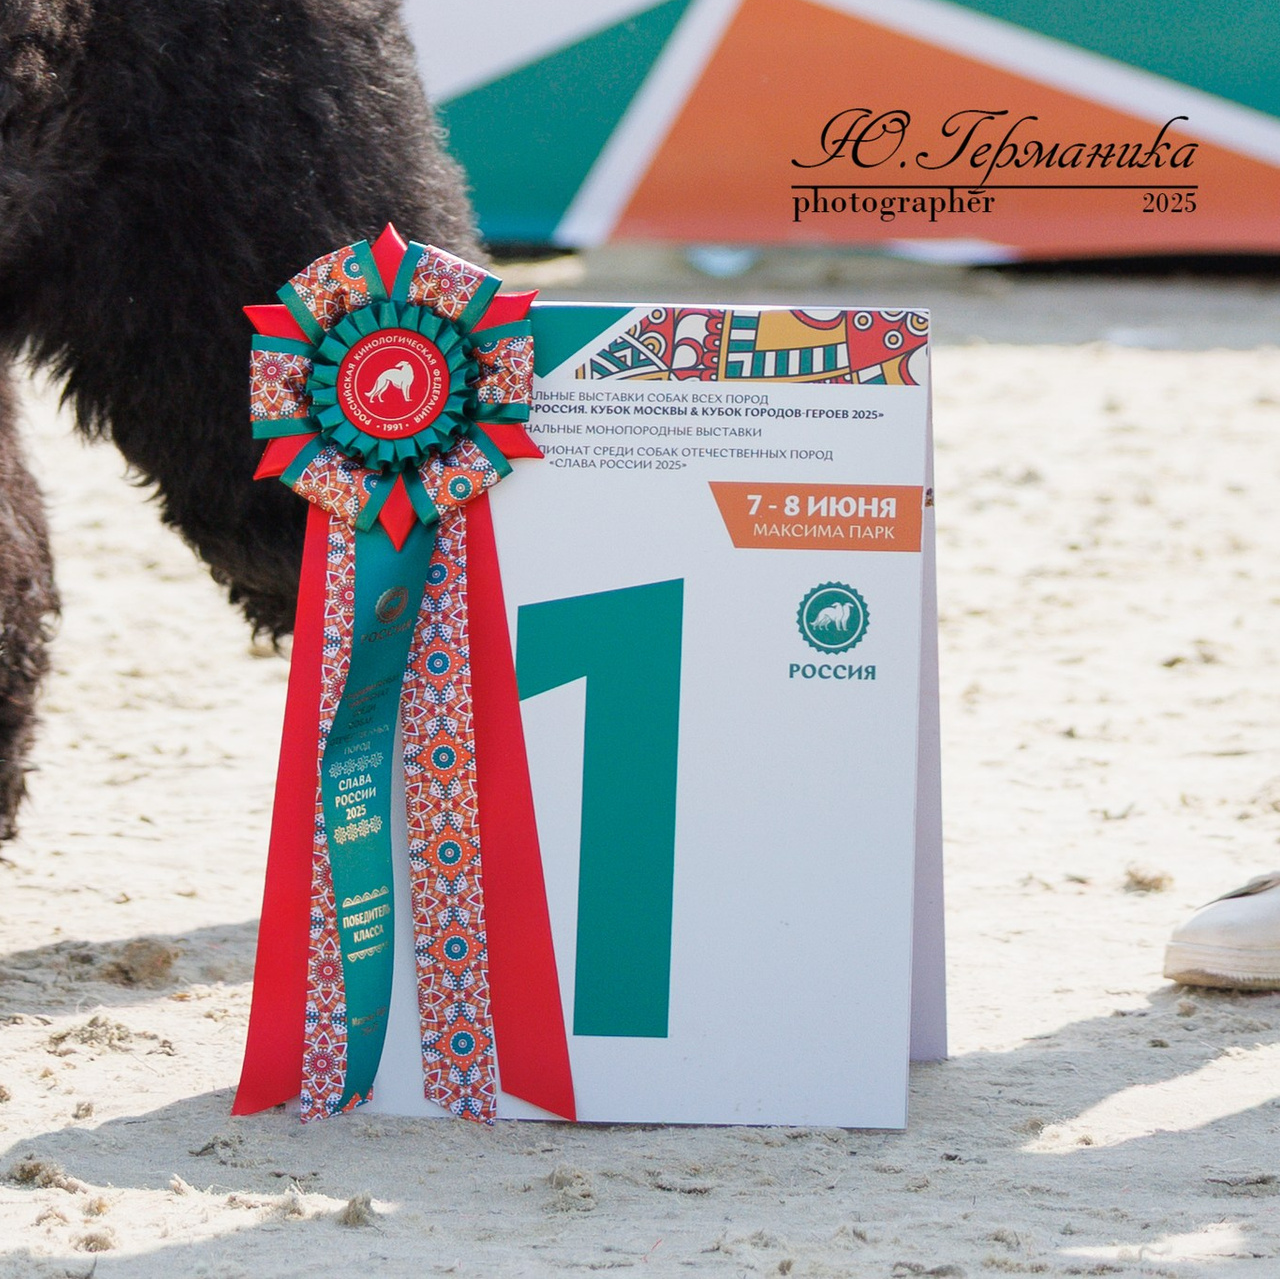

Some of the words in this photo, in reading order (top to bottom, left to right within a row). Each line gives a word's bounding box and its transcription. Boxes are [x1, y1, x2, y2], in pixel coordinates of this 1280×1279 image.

[353, 335, 437, 366] КИНОЛОГИЧЕСКАЯ
[343, 362, 372, 426] РОССИЙСКАЯ
[413, 368, 442, 424] ФЕДЕРАЦИЯ
[578, 392, 644, 403] ВЫСТАВКИ
[647, 392, 688, 404] СОБАК
[691, 393, 723, 404] ВСЕХ
[725, 394, 769, 405] ПОРОД
[590, 405, 631, 415] КУБОК
[633, 405, 687, 416] МОСКВЫ
[690, 407, 699, 417] &
[701, 407, 742, 417] КУБОК
[744, 408, 849, 419] ГОРОДОВ-ГЕРОЕВ
[851, 409, 884, 420] 2025»
[382, 423, 404, 432] 1991
[585, 424, 693, 437] МОНОПОРОДНЫЕ
[696, 426, 762, 437] ВЫСТАВКИ
[593, 445, 634, 458] СРЕДИ
[636, 447, 678, 458] СОБАК
[681, 447, 787, 459] ОТЕЧЕСТВЕННЫХ
[790, 449, 834, 461] ПОРОД
[549, 458, 597, 469] «СЛАВА
[599, 459, 653, 470] РОССИИ
[655, 460, 687, 470] 2025»
[746, 494, 763, 516] 7
[783, 495, 800, 516] 8
[807, 495, 897, 519] ИЮНЯ
[753, 523, 845, 538] МАКСИМА
[849, 525, 895, 540] ПАРК
[789, 663, 876, 681] РОССИЯ
[338, 773, 372, 791] СЛАВА
[334, 786, 377, 808] РОССИИ
[345, 804, 367, 821] 2025
[515, 577, 684, 1038] 1
[342, 903, 391, 929] ПОБЕДИТЕЛЬ
[353, 924, 385, 944] КЛАССА
